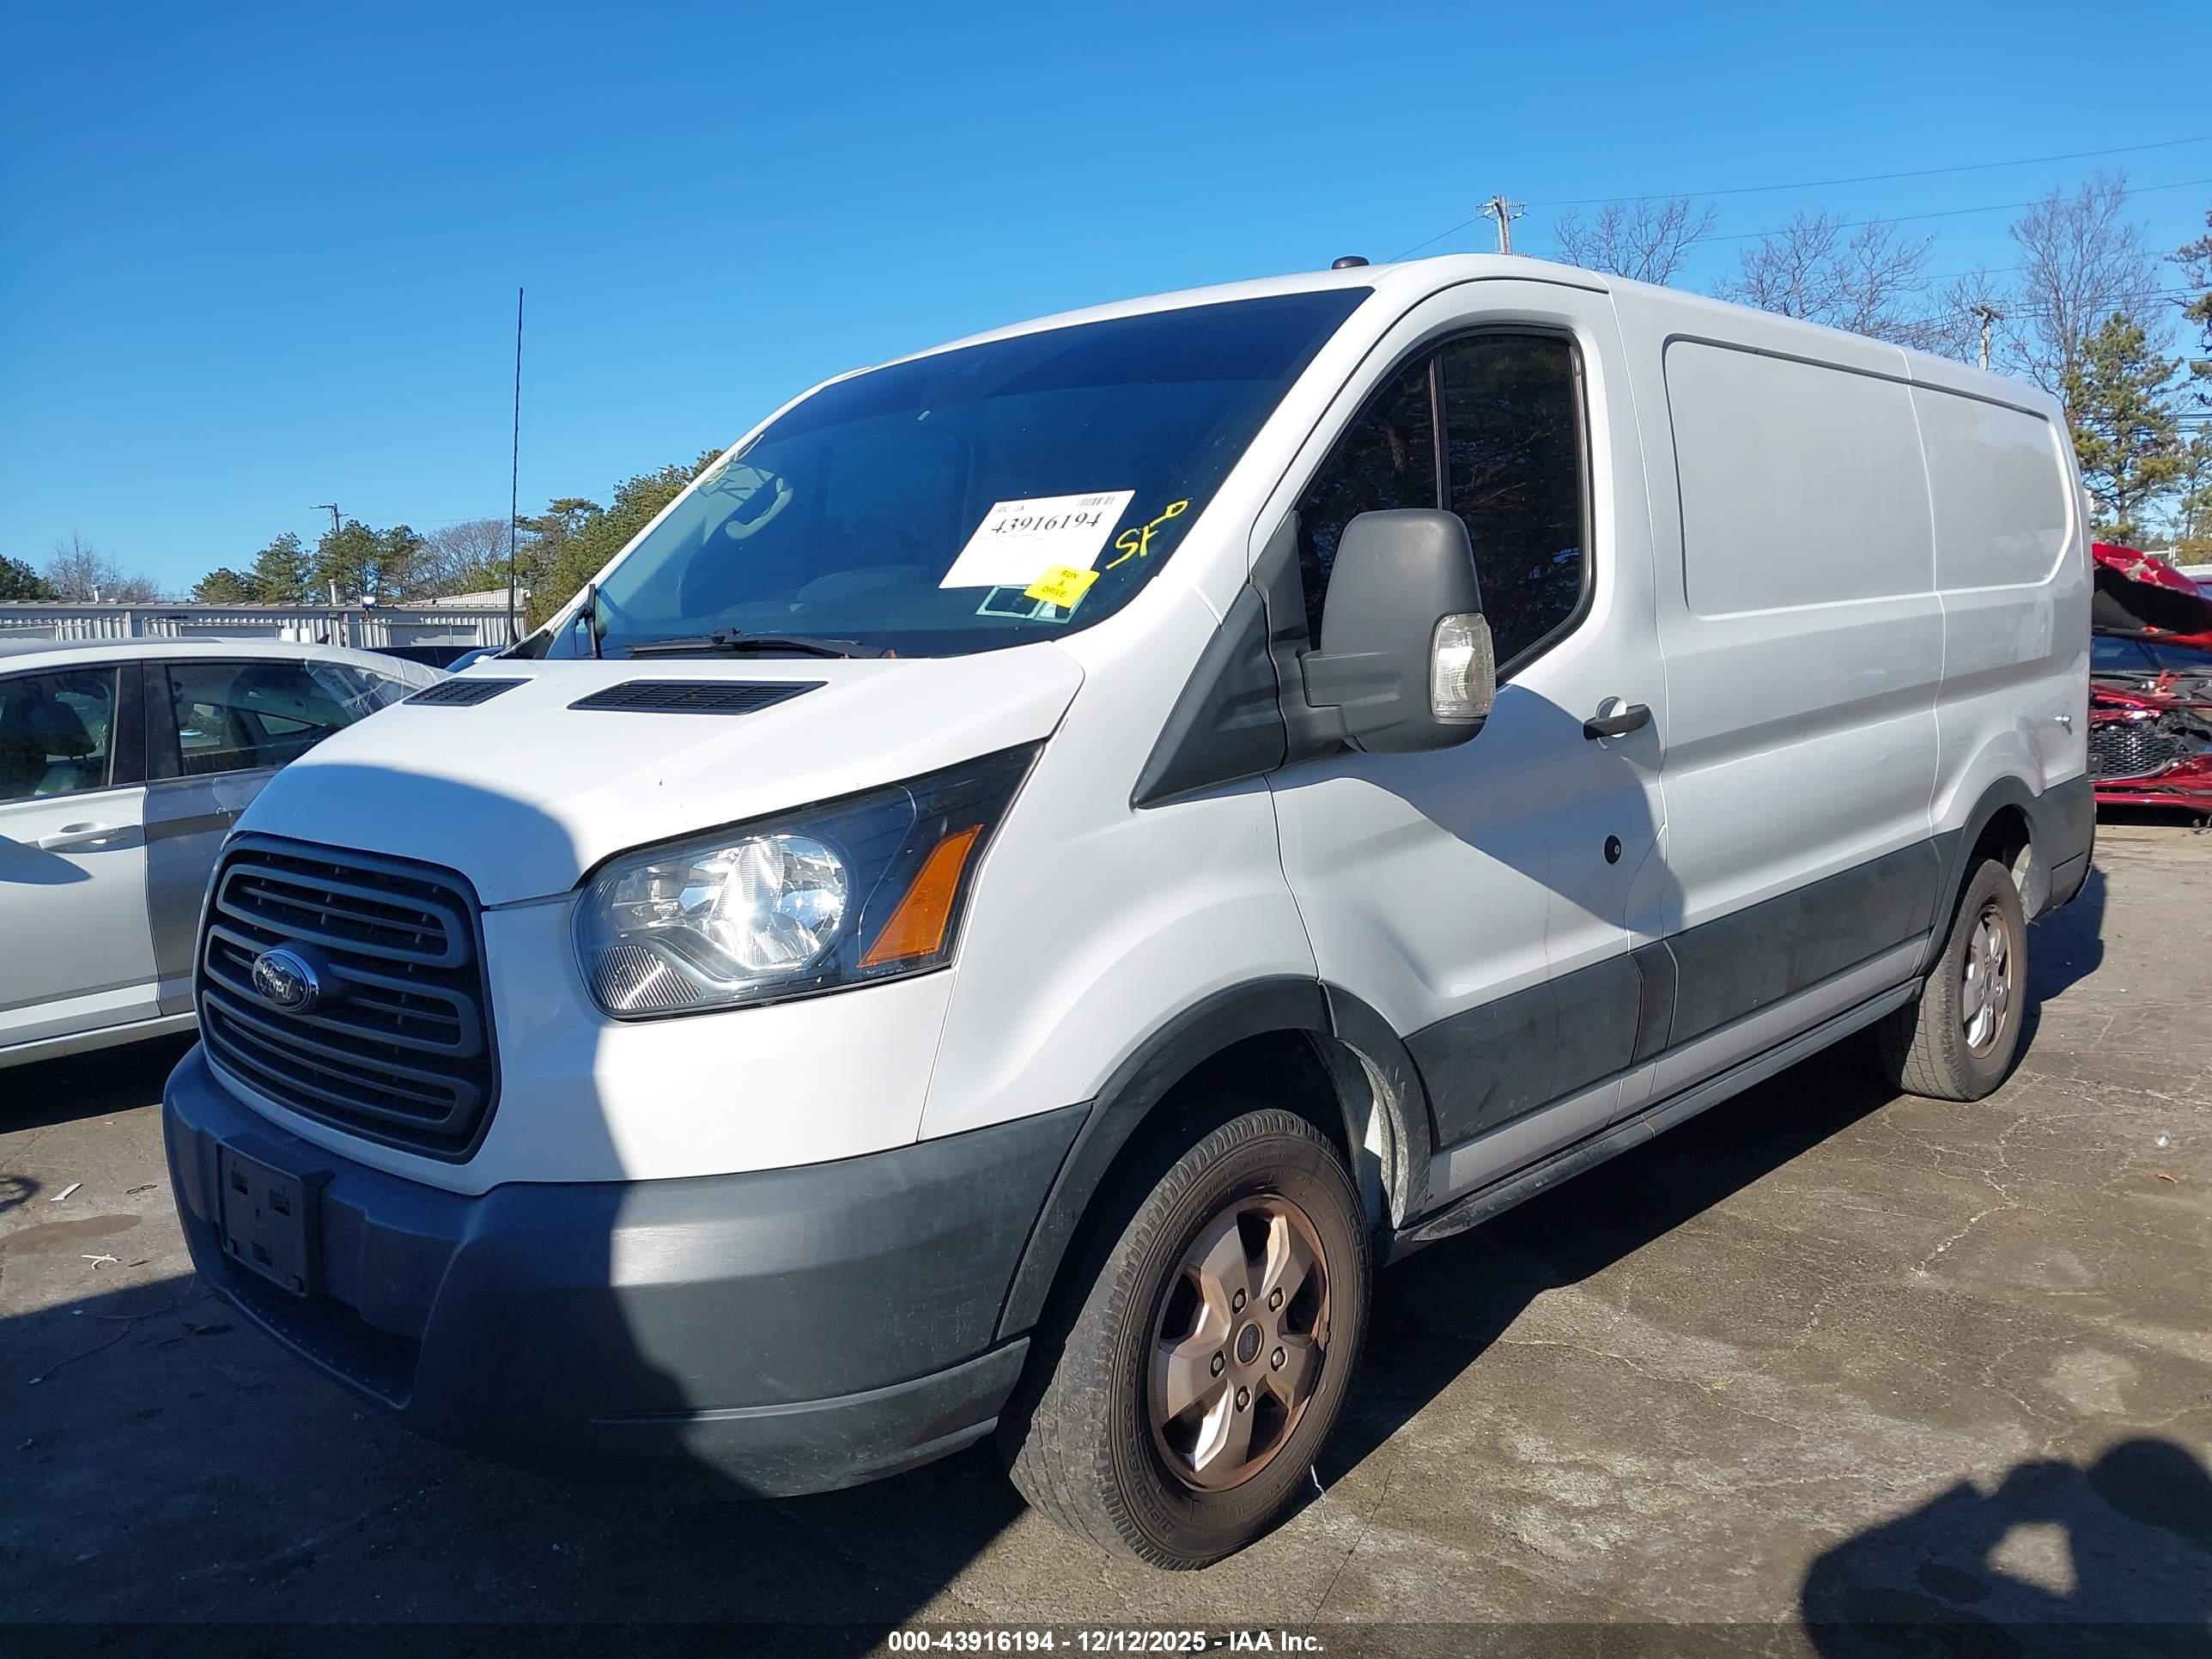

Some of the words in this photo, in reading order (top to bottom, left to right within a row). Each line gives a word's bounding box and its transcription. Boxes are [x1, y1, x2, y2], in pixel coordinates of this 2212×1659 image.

[991, 511, 1103, 534] 43916194
[1060, 569, 1079, 580] RUN
[1041, 586, 1067, 598] DRIVE
[261, 958, 294, 1001] Ford
